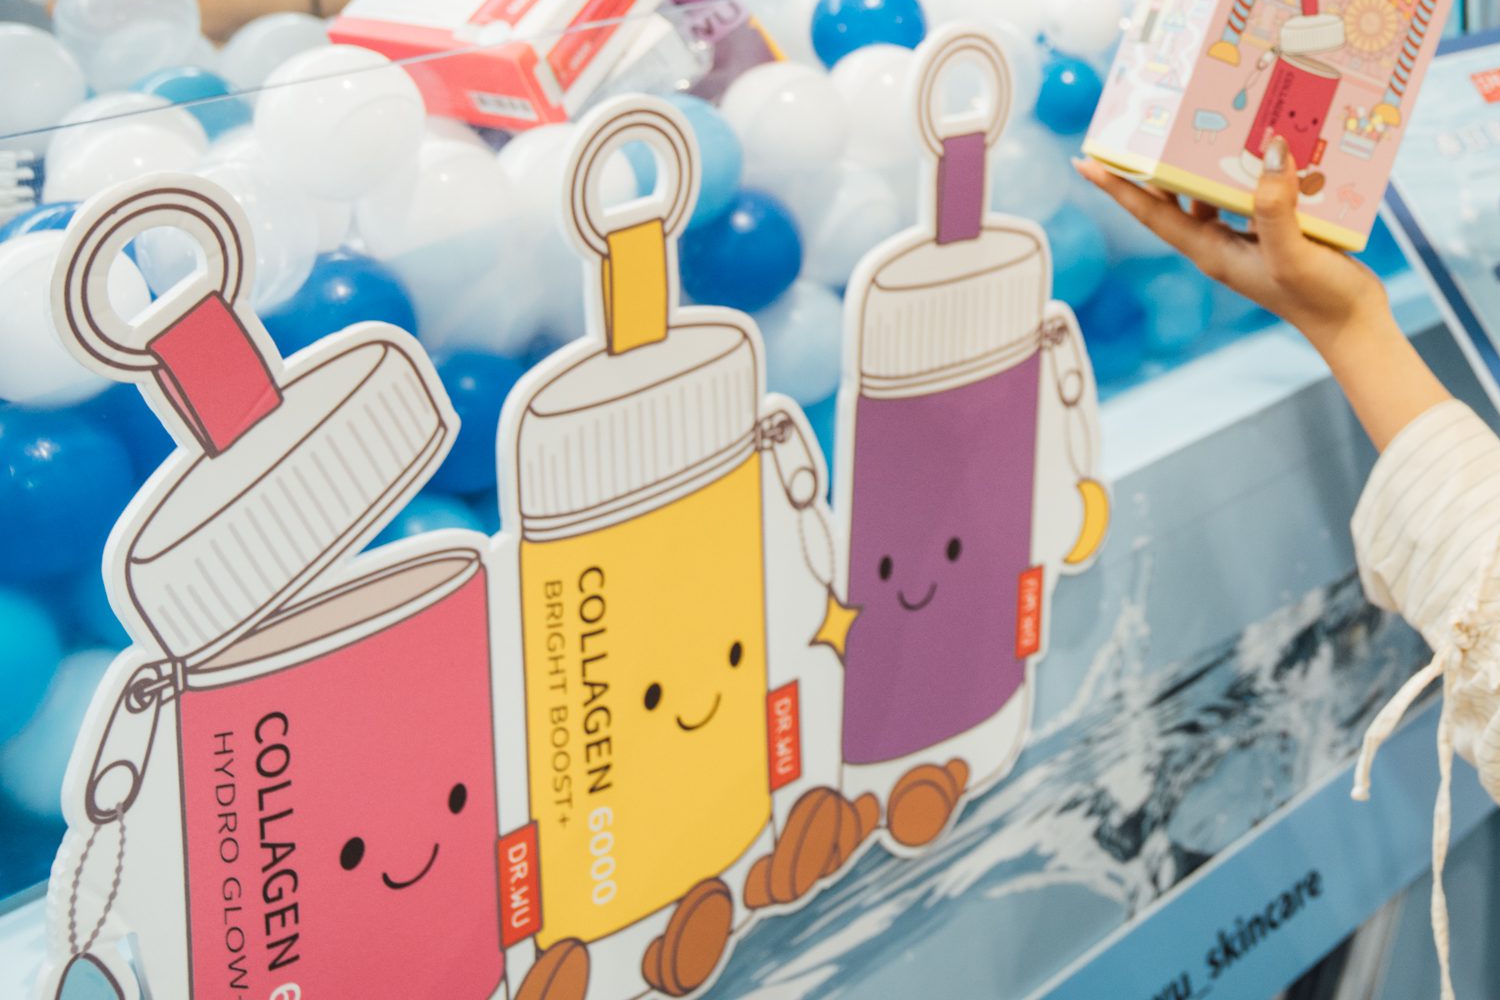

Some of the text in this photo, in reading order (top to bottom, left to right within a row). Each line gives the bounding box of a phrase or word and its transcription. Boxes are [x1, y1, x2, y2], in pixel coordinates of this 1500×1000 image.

[544, 580, 573, 829] BRIGHT BOOST+
[578, 565, 618, 906] COLLAGEN 6000
[774, 696, 794, 775] DR.WU
[213, 731, 250, 1000] HYDRO GLOW
[254, 711, 301, 973] COLLAGEN
[507, 841, 531, 929] DR.WU
